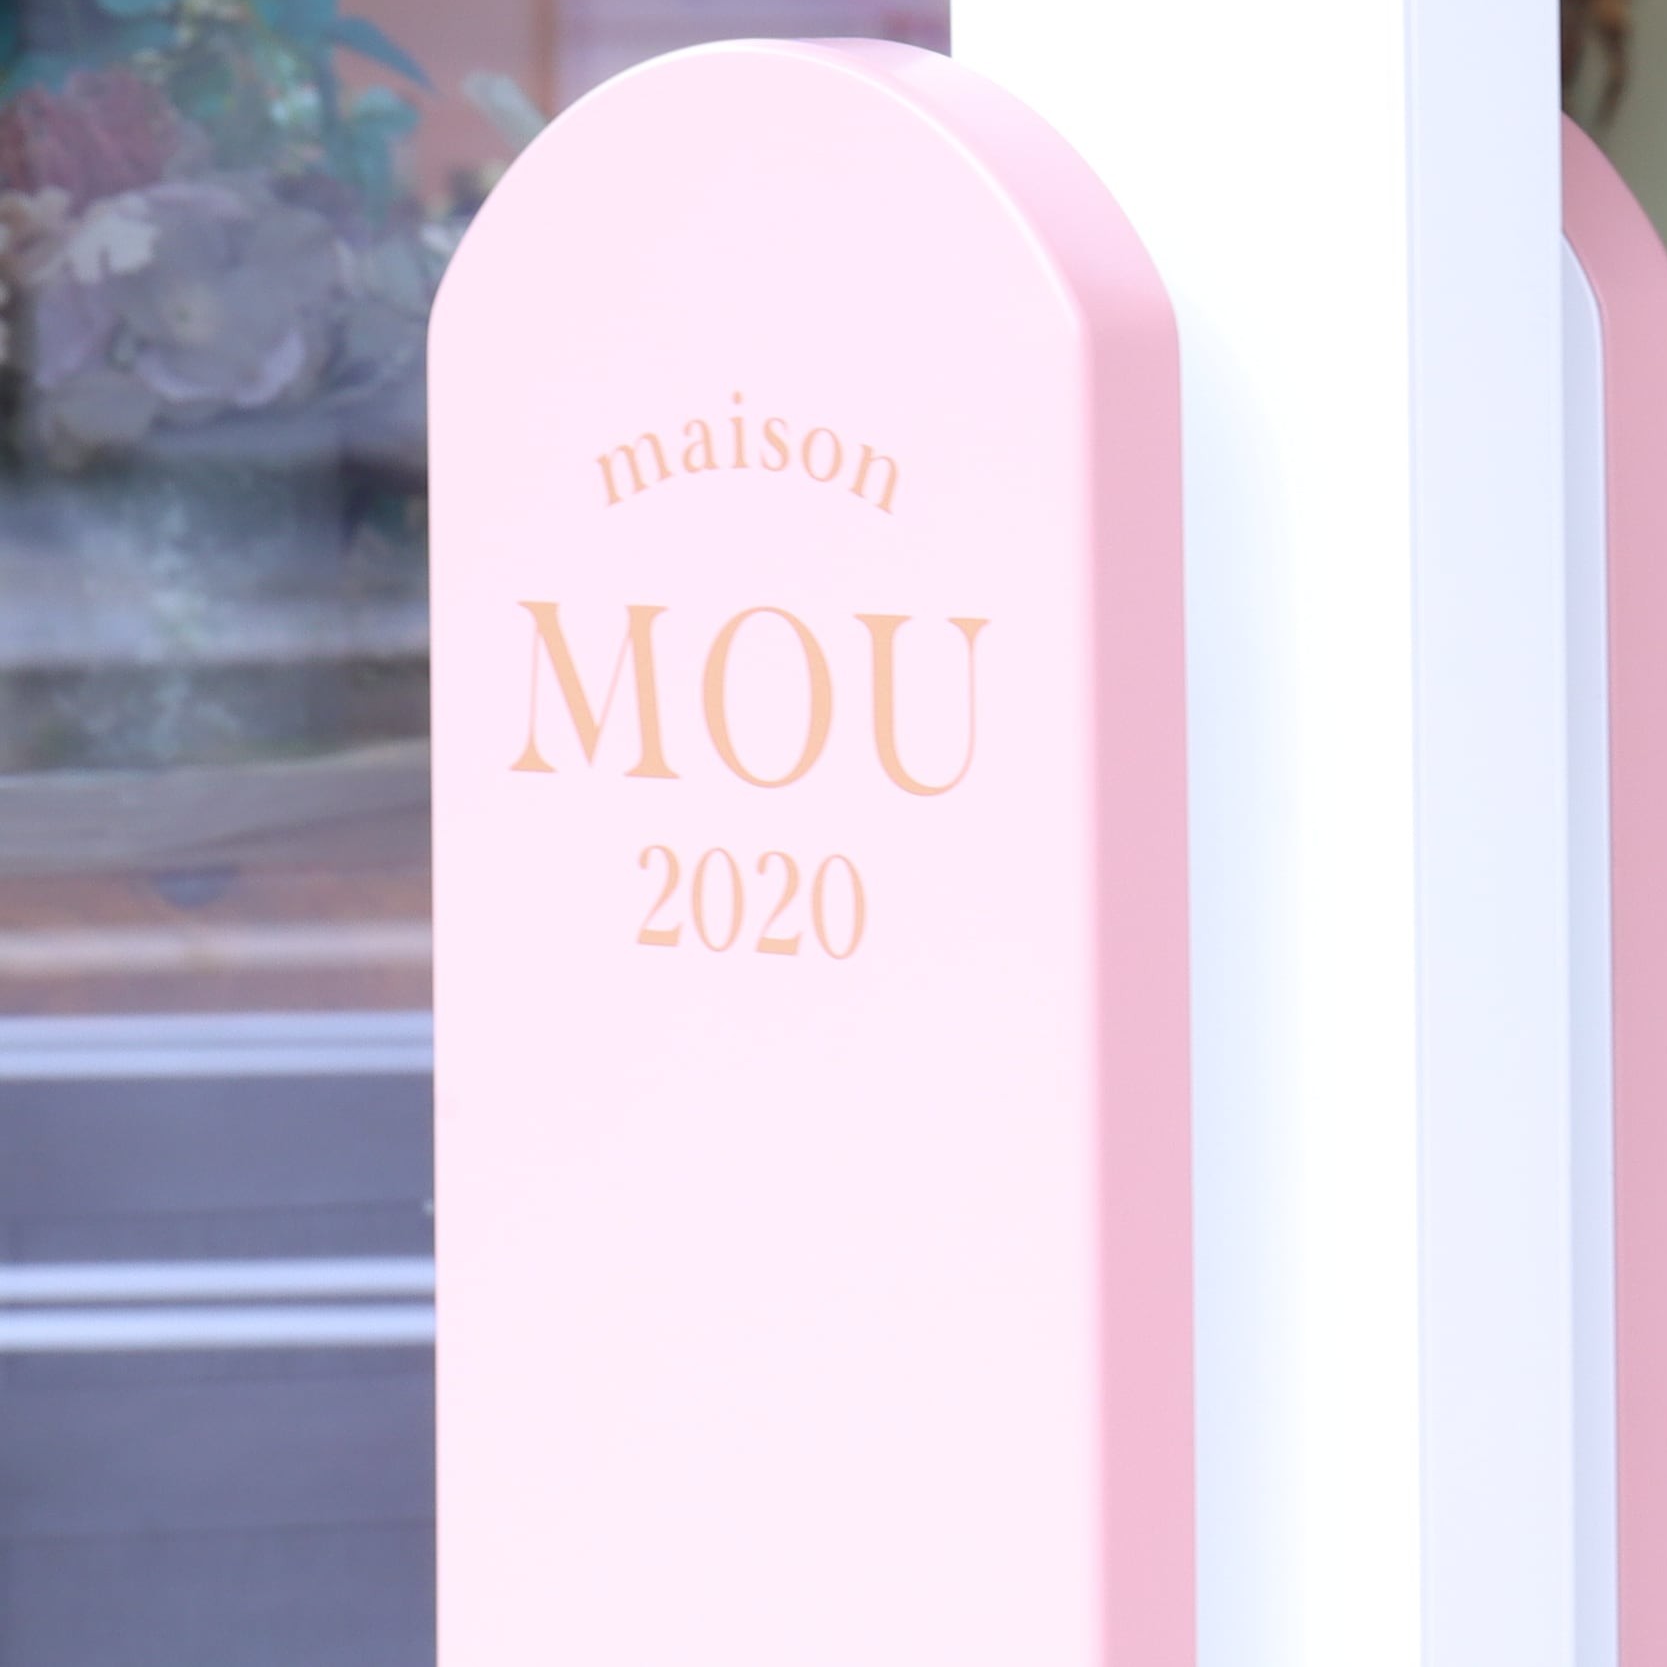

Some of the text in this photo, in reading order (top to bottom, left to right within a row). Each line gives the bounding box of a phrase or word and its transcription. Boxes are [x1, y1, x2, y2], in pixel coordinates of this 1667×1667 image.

[596, 390, 899, 515] maison
[509, 599, 992, 797] MOU
[636, 843, 867, 960] 2020
